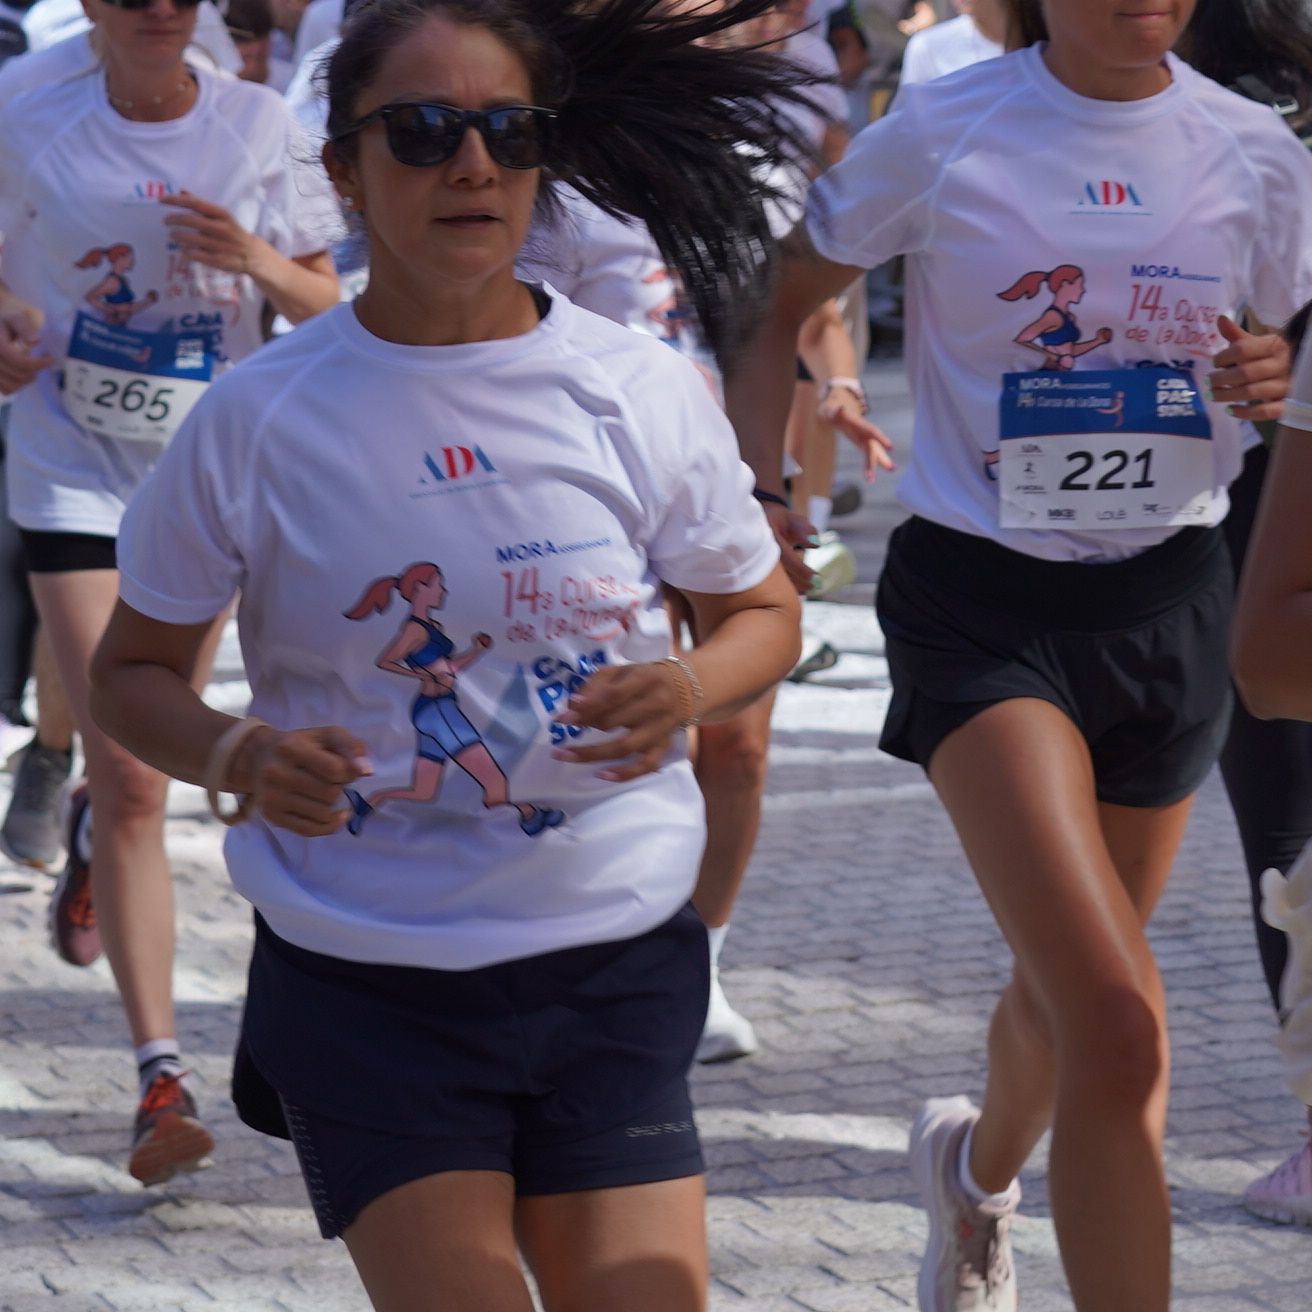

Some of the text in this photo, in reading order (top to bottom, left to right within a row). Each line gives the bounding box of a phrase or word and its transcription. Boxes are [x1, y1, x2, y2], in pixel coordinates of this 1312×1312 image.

[1078, 181, 1143, 207] ADA
[1131, 264, 1180, 278] MORA
[93, 378, 175, 422] 265
[417, 442, 498, 483] ADA
[1059, 448, 1156, 491] 221
[496, 539, 558, 563] MORA
